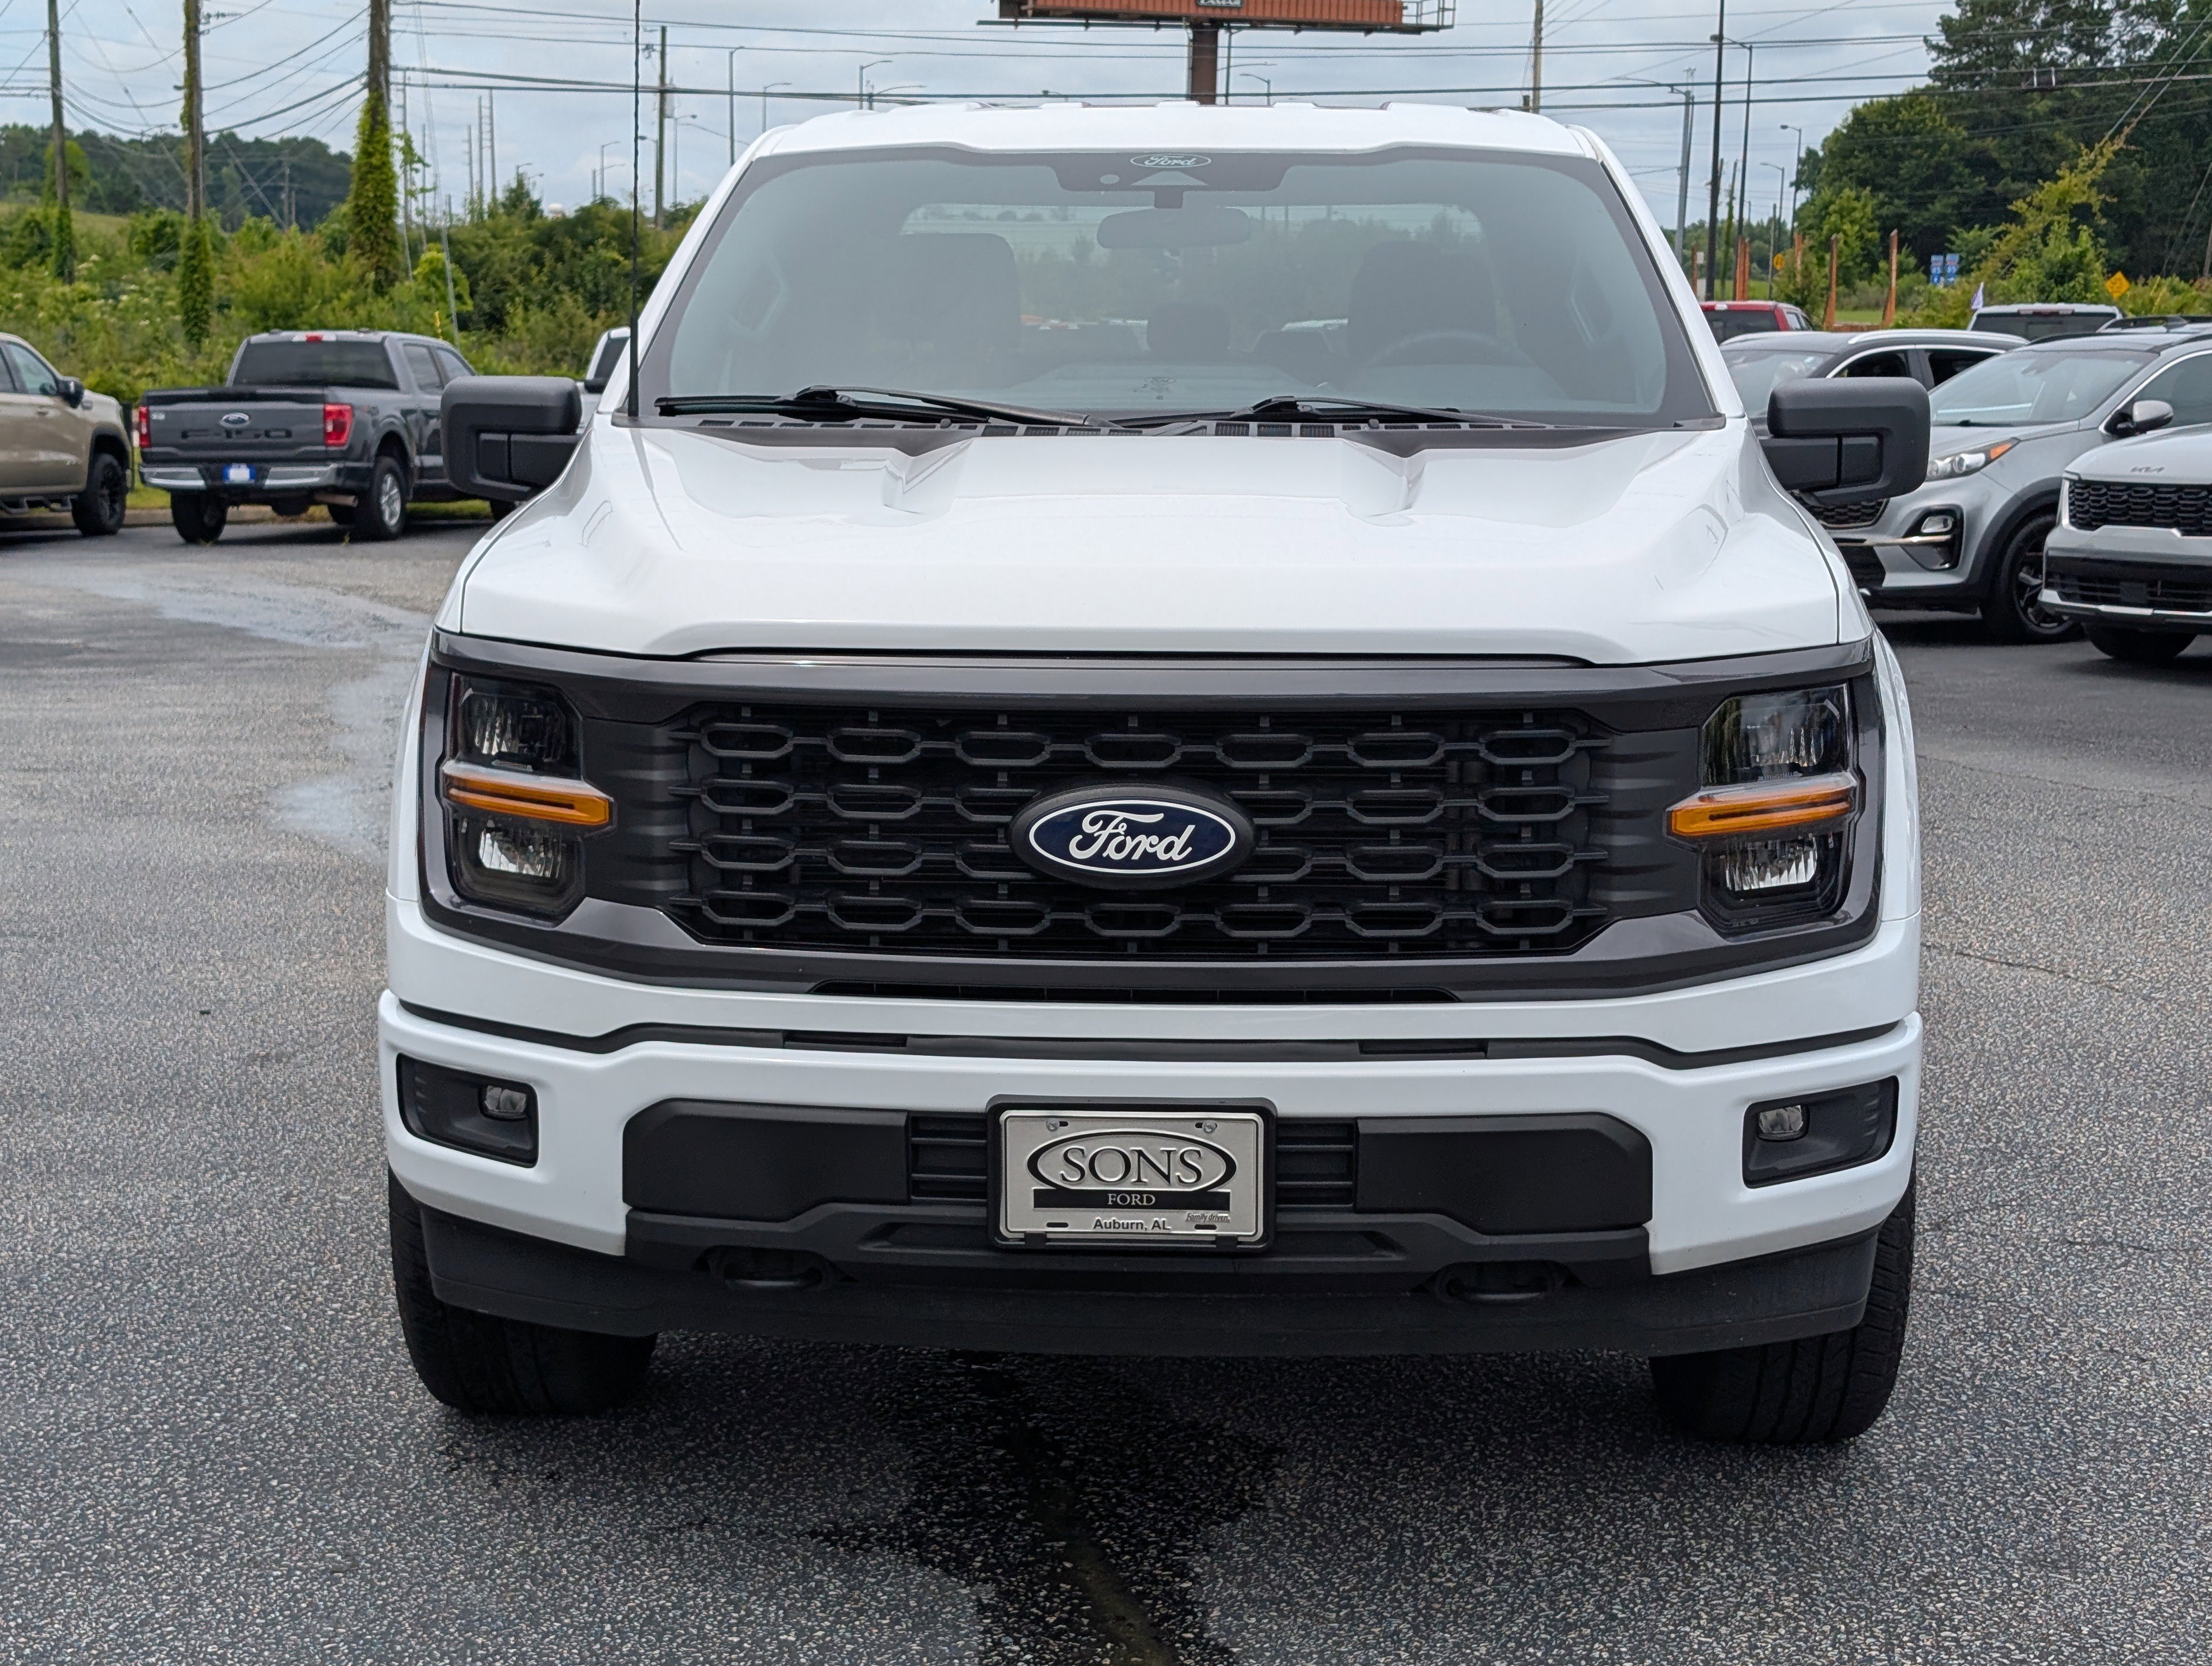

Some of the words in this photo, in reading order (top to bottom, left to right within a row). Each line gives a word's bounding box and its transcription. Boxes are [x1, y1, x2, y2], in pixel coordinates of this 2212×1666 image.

[1144, 155, 1197, 165] Ford
[1069, 810, 1195, 860] Ford
[1059, 1146, 1203, 1184] SONS
[1107, 1194, 1156, 1205] FORD
[1186, 1213, 1208, 1223] Family
[1093, 1218, 1148, 1231] Auburn,
[1151, 1219, 1172, 1231] AL
